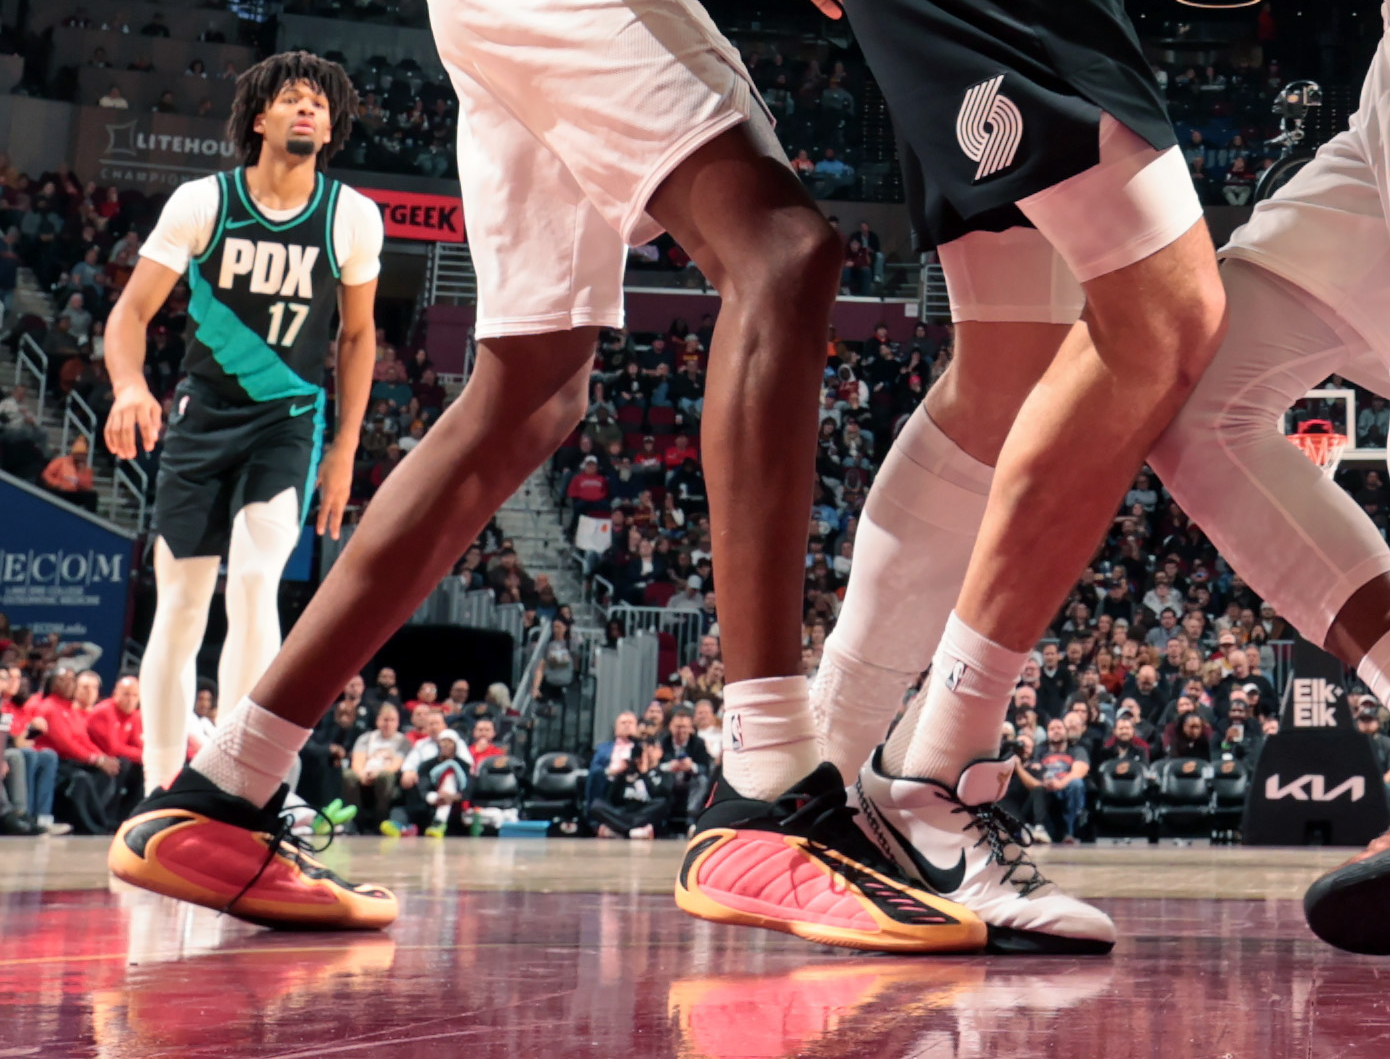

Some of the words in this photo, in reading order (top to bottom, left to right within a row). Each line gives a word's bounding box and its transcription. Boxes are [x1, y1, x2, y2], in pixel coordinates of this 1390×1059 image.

[218, 237, 321, 299] PDX
[267, 300, 311, 348] 17
[1293, 703, 1337, 727] Elk
[1264, 773, 1366, 802] KIA
